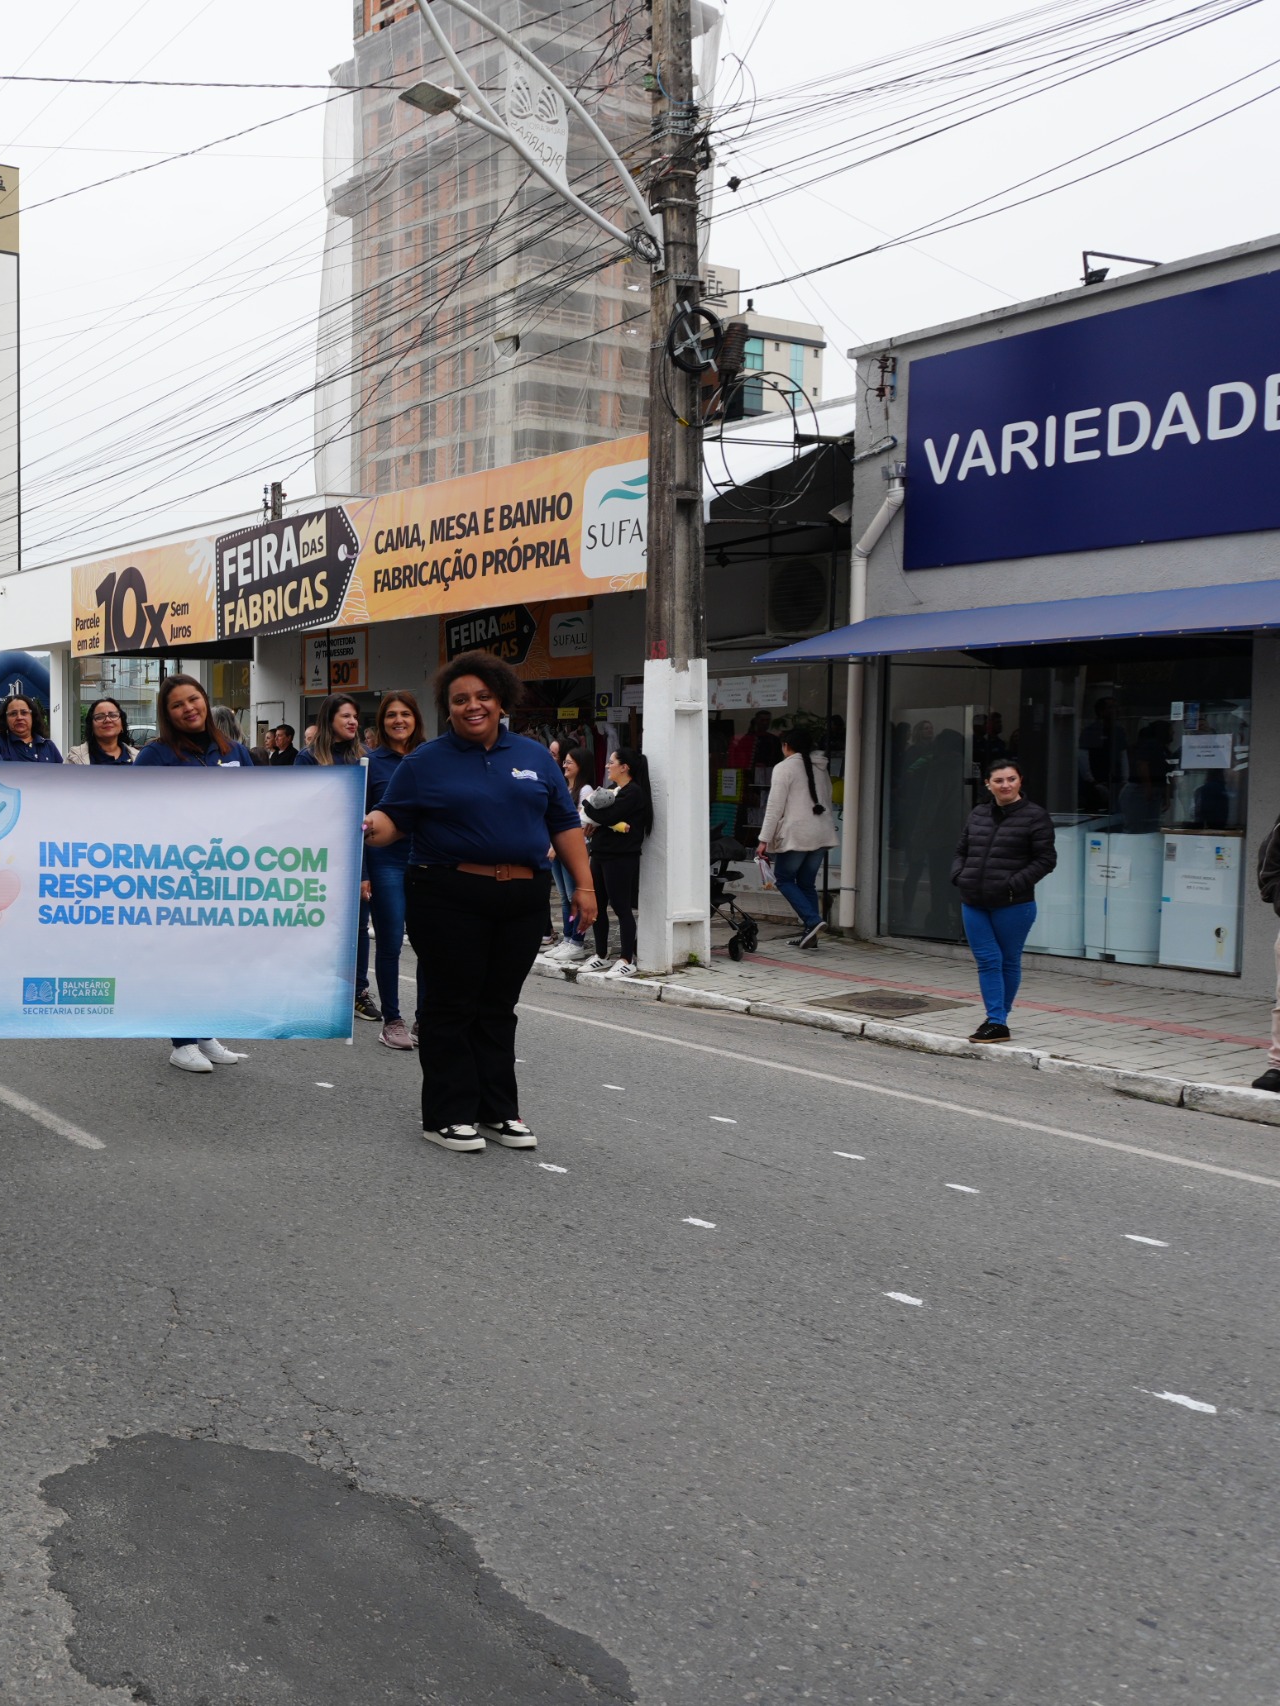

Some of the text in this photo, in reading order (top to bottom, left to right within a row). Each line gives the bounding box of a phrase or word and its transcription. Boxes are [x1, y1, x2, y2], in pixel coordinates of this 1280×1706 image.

[374, 491, 573, 555] CAMA, MESA E BANHO
[585, 518, 644, 550] SUFA
[223, 525, 324, 592] FEIRA DAS
[373, 536, 571, 594] FABRICAÇÃO PRÓPRIA
[95, 566, 169, 653] 10x
[170, 601, 189, 617] Sem
[224, 570, 329, 636] FÁBRICAS
[75, 613, 100, 631] Parcele
[450, 615, 516, 649] FEIRA DAS
[77, 632, 100, 651] em até
[169, 624, 192, 642] Juros
[314, 636, 356, 649] CAPA ROTETORA
[553, 632, 588, 647] SUFALU
[322, 647, 355, 658] TRVESSEIRO
[314, 665, 319, 676] 4
[333, 662, 350, 684] 30
[39, 838, 328, 879] INFORMAÇÃO COM
[39, 873, 327, 902] RESPONSABILIDADE:
[38, 900, 325, 928] SAÚDE NA PALMA DA MÃO
[62, 979, 110, 989] BALNEÁRIO
[62, 988, 109, 998] PIÇARRAS
[22, 1006, 114, 1015] SECRETARIA DE SAÚDE
